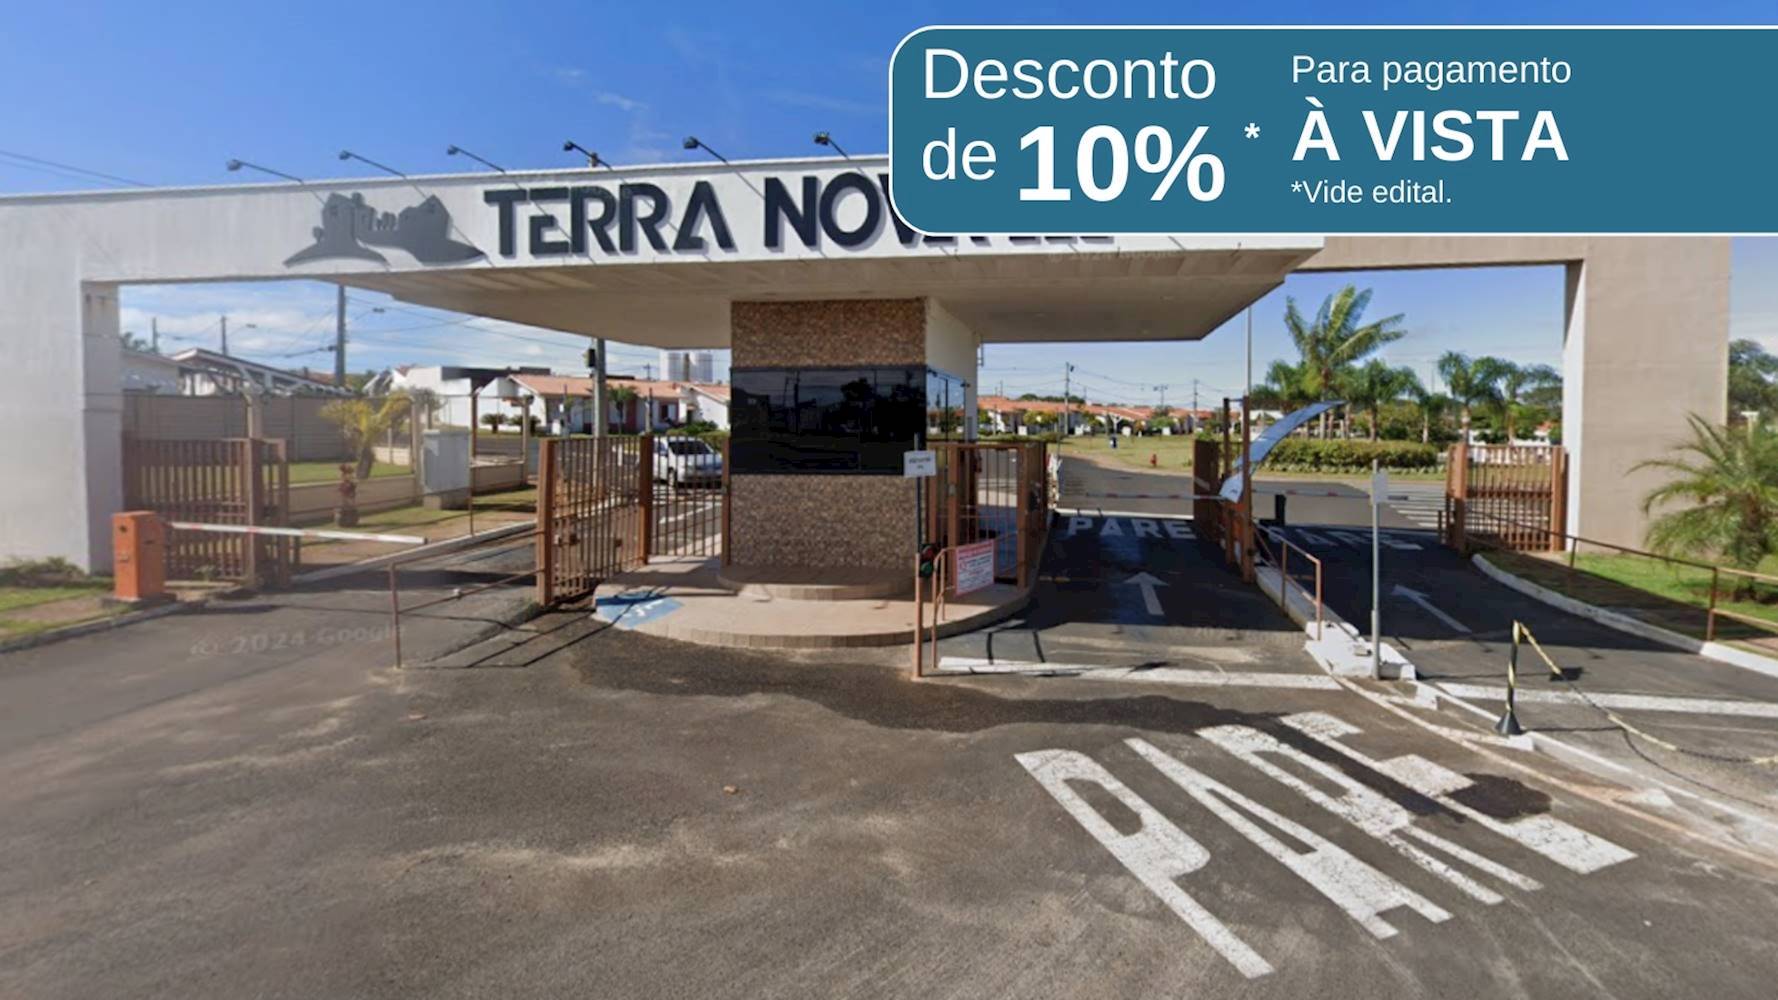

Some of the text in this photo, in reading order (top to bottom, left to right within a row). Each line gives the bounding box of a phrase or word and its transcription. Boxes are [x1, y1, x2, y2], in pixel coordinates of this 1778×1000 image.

[483, 181, 737, 257] TERRA
[1067, 516, 1198, 540] PARE
[1014, 710, 1639, 979] PARE
